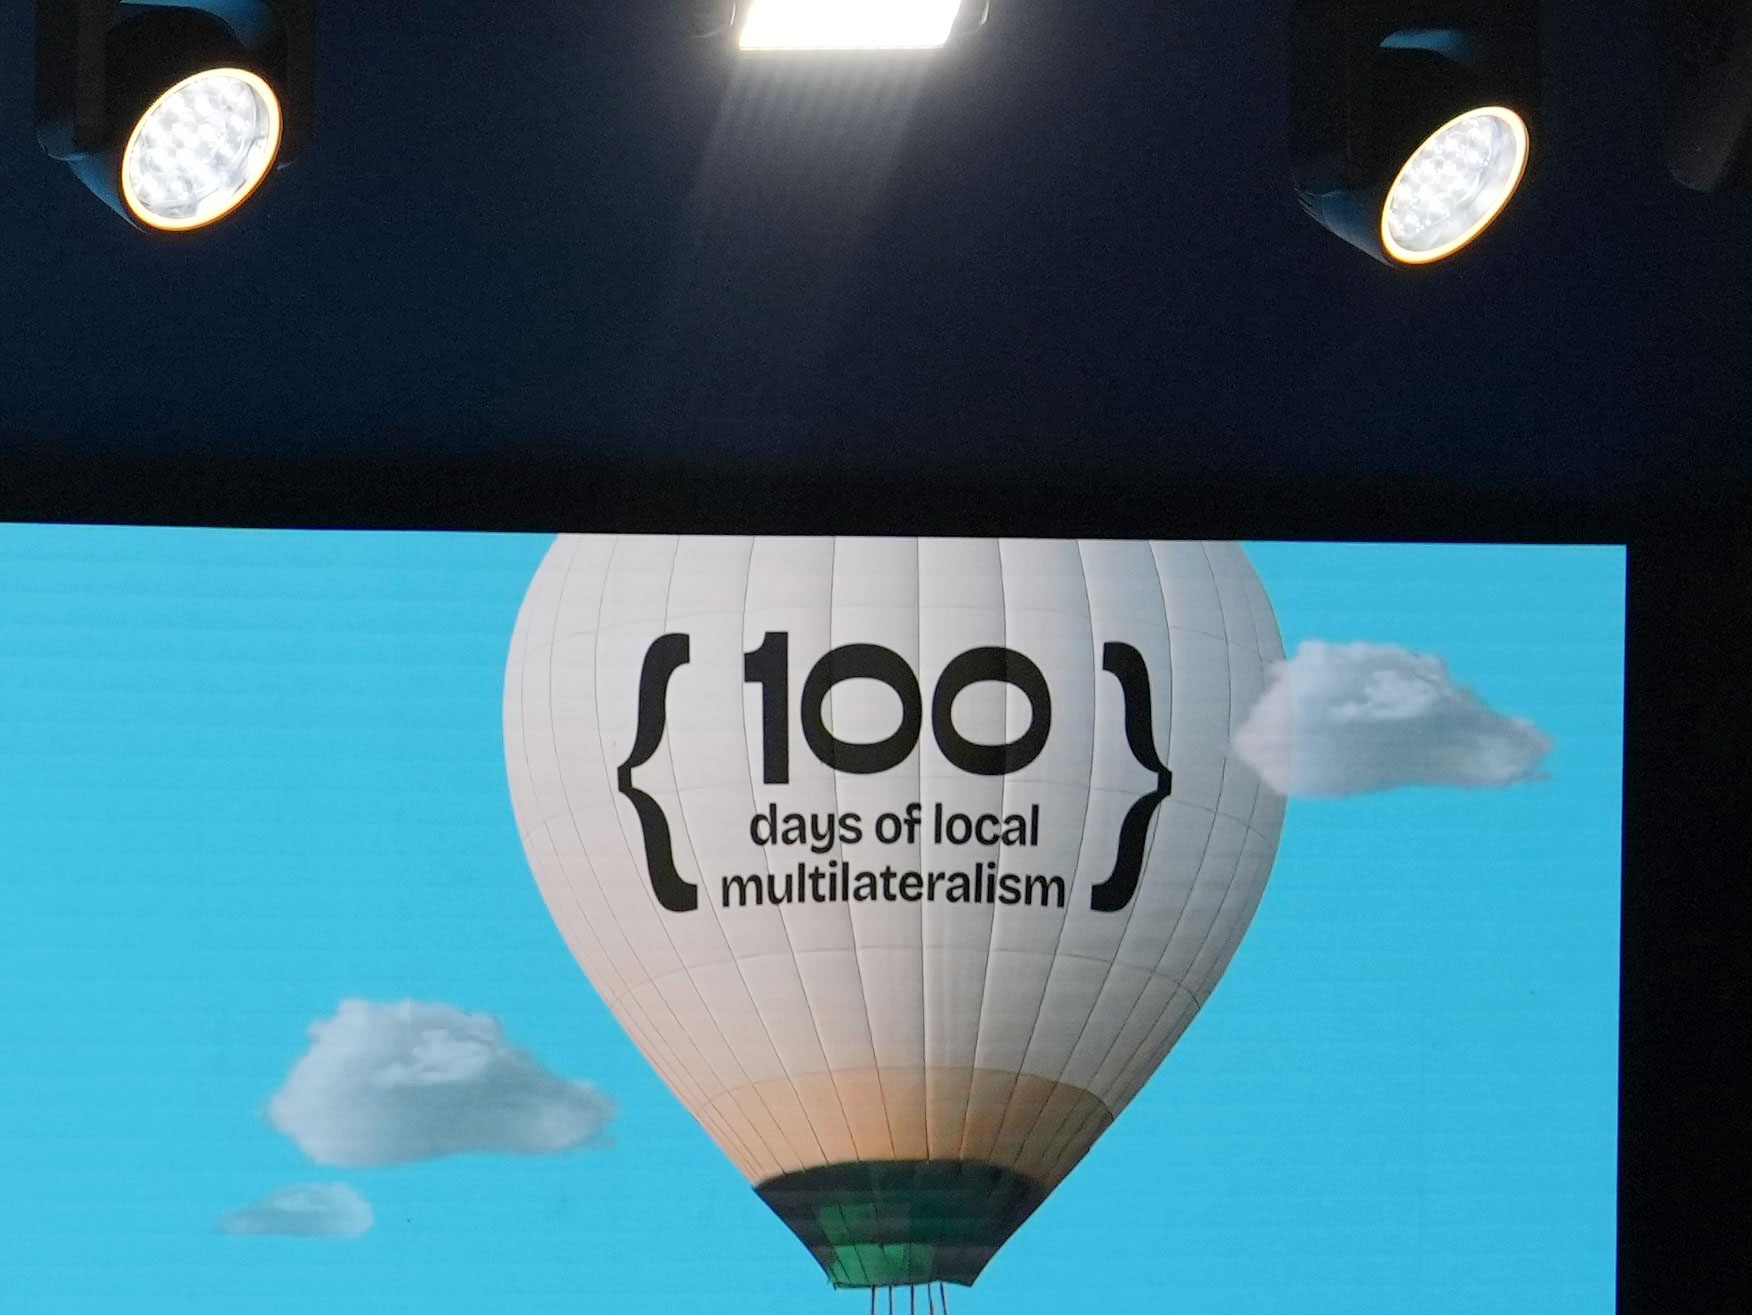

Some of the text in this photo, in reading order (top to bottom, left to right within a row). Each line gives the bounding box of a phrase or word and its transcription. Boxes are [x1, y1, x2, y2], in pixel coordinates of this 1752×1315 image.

[744, 631, 1052, 785] 100
[749, 803, 1039, 855] days of local
[721, 861, 1066, 908] multilateralism
